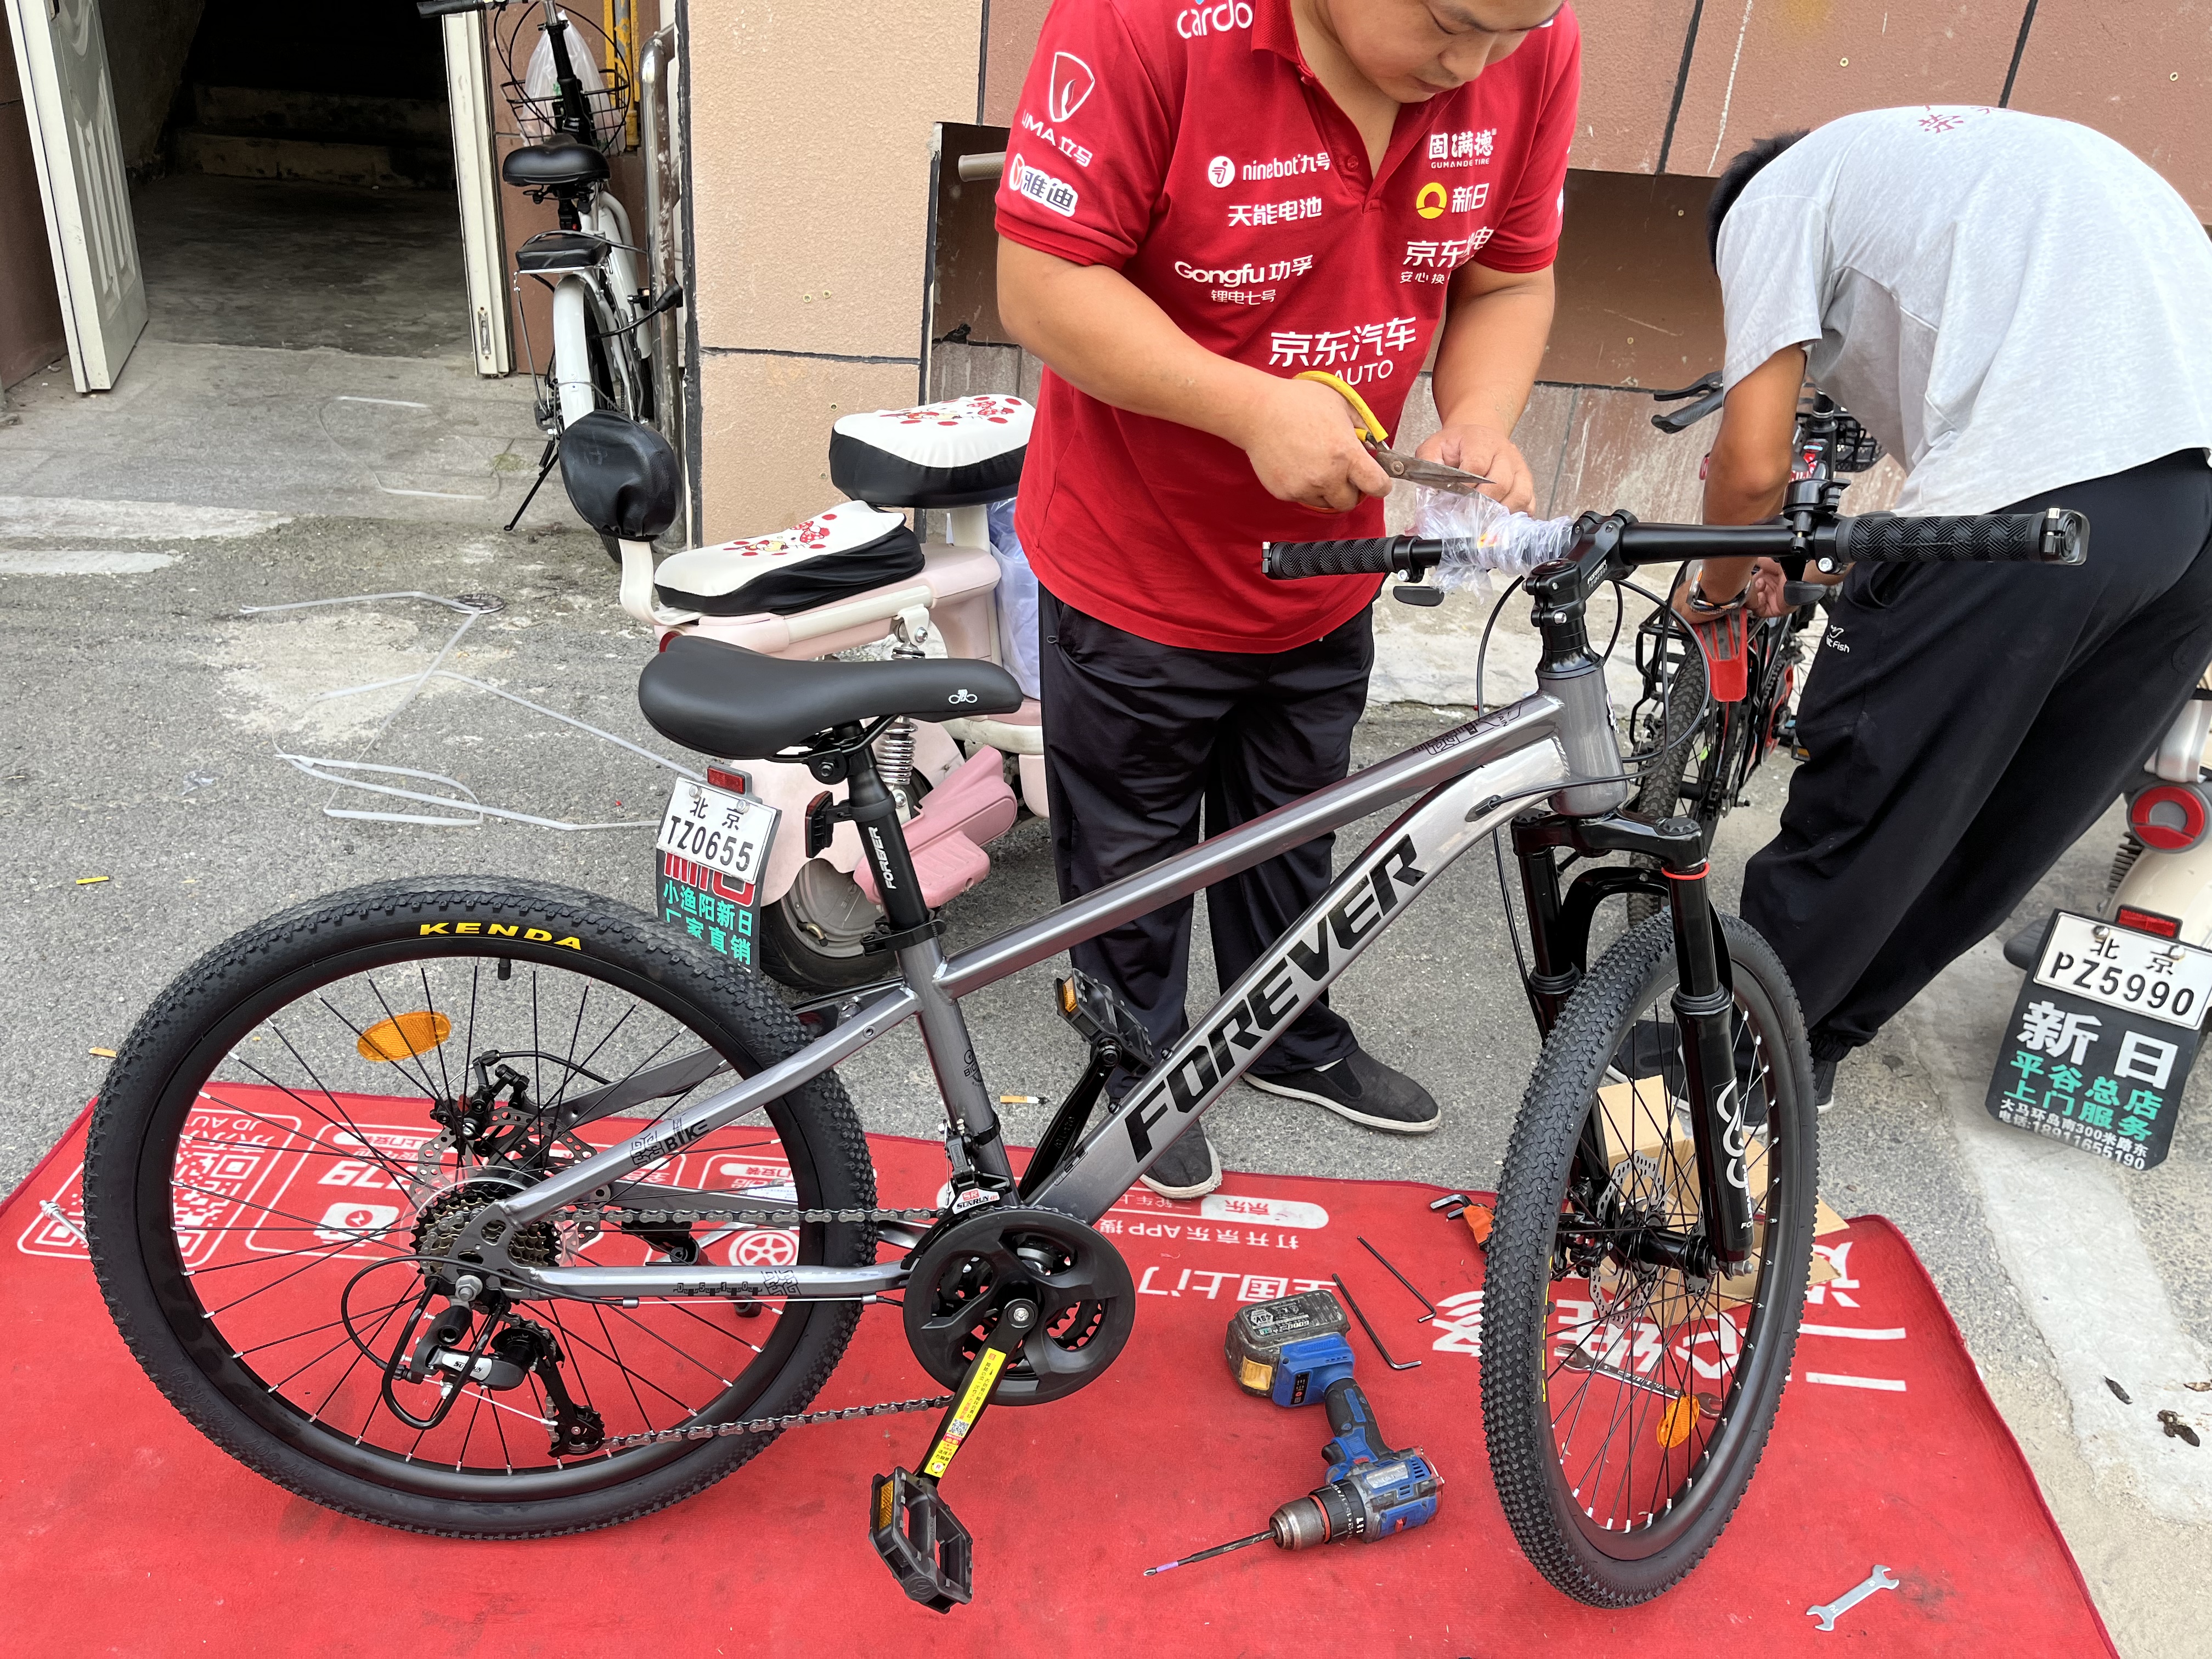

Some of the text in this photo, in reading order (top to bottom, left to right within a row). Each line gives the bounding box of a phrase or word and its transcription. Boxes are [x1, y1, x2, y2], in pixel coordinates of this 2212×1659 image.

[1177, 0, 1253, 39] cardo
[1058, 136, 1093, 167] 立马
[1429, 129, 1493, 160] 固满德
[1243, 151, 1330, 180] ninebot 九号
[1430, 160, 1472, 169] GUMANDE
[1023, 170, 1074, 212] 雅迪
[1451, 183, 1490, 213] 新日
[1228, 196, 1322, 227] 天能电池
[1174, 255, 1313, 287] Gongfu 功孚
[1400, 271, 1450, 285] 安心换
[1210, 289, 1277, 305] 锂电七号
[1268, 316, 1417, 367] 京东汽车
[690, 797, 745, 831] 北京
[668, 815, 754, 872] TZ0655
[868, 826, 897, 890] FOREVER
[663, 879, 753, 938] 小渔阳新日
[420, 922, 582, 951] KENDA
[665, 907, 752, 966] 厂家直销
[2090, 938, 2176, 976] 北京
[1124, 833, 1428, 1163] FOREVER
[2050, 951, 2194, 1016] PZ5990
[2016, 1000, 2179, 1090] 新日
[2010, 1049, 2163, 1121] 平谷总店
[232, 1119, 263, 1132] JD
[2004, 1079, 2153, 1142] 上门服务
[185, 1129, 275, 1153] 京东
[957, 1195, 989, 1209] SUNRUN
[962, 1190, 979, 1200] SR
[1224, 1199, 1270, 1216] 京东
[453, 1361, 483, 1372] SUUN
